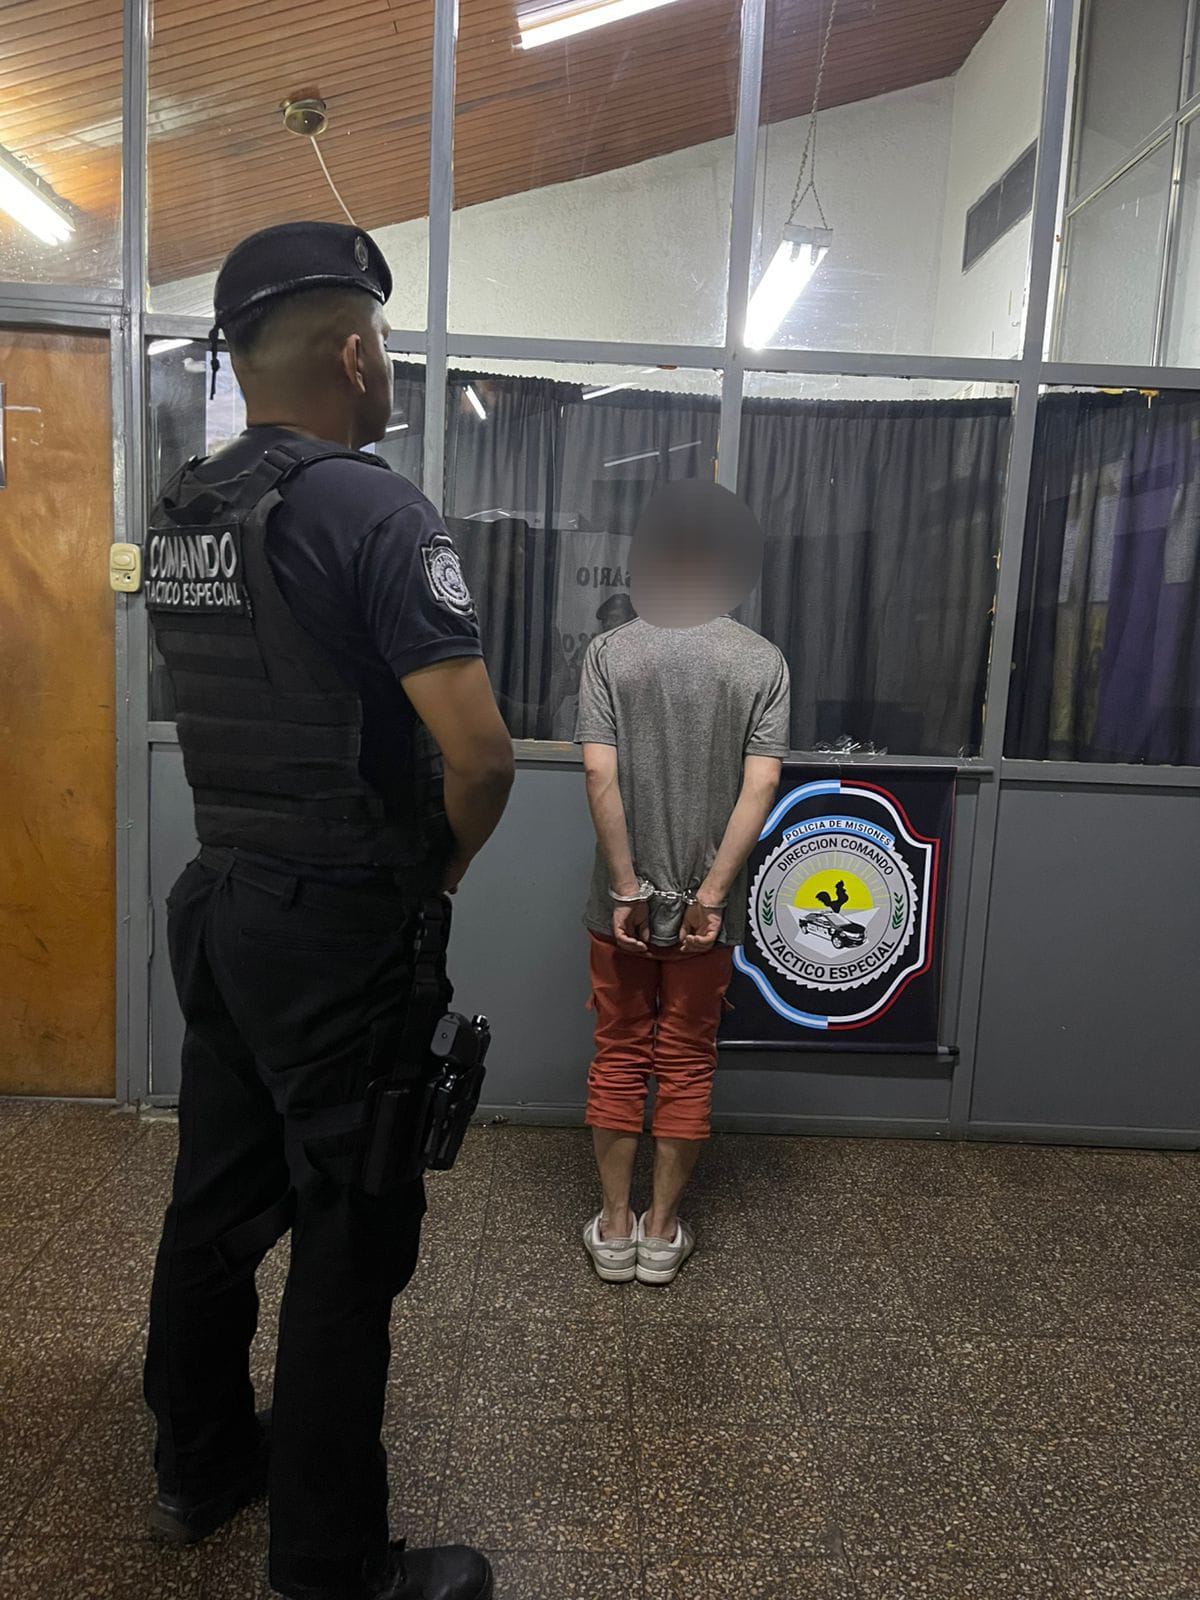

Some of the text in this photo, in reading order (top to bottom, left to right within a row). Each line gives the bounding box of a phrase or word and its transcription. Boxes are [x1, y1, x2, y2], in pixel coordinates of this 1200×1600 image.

[150, 532, 237, 578] COMANDO
[183, 582, 241, 606] ESPECIAL
[785, 820, 891, 846] POLICIA DE MISIONES
[777, 838, 894, 876] DIRECCION COMANDO
[769, 935, 895, 979] TACTICO ESPECIAL
